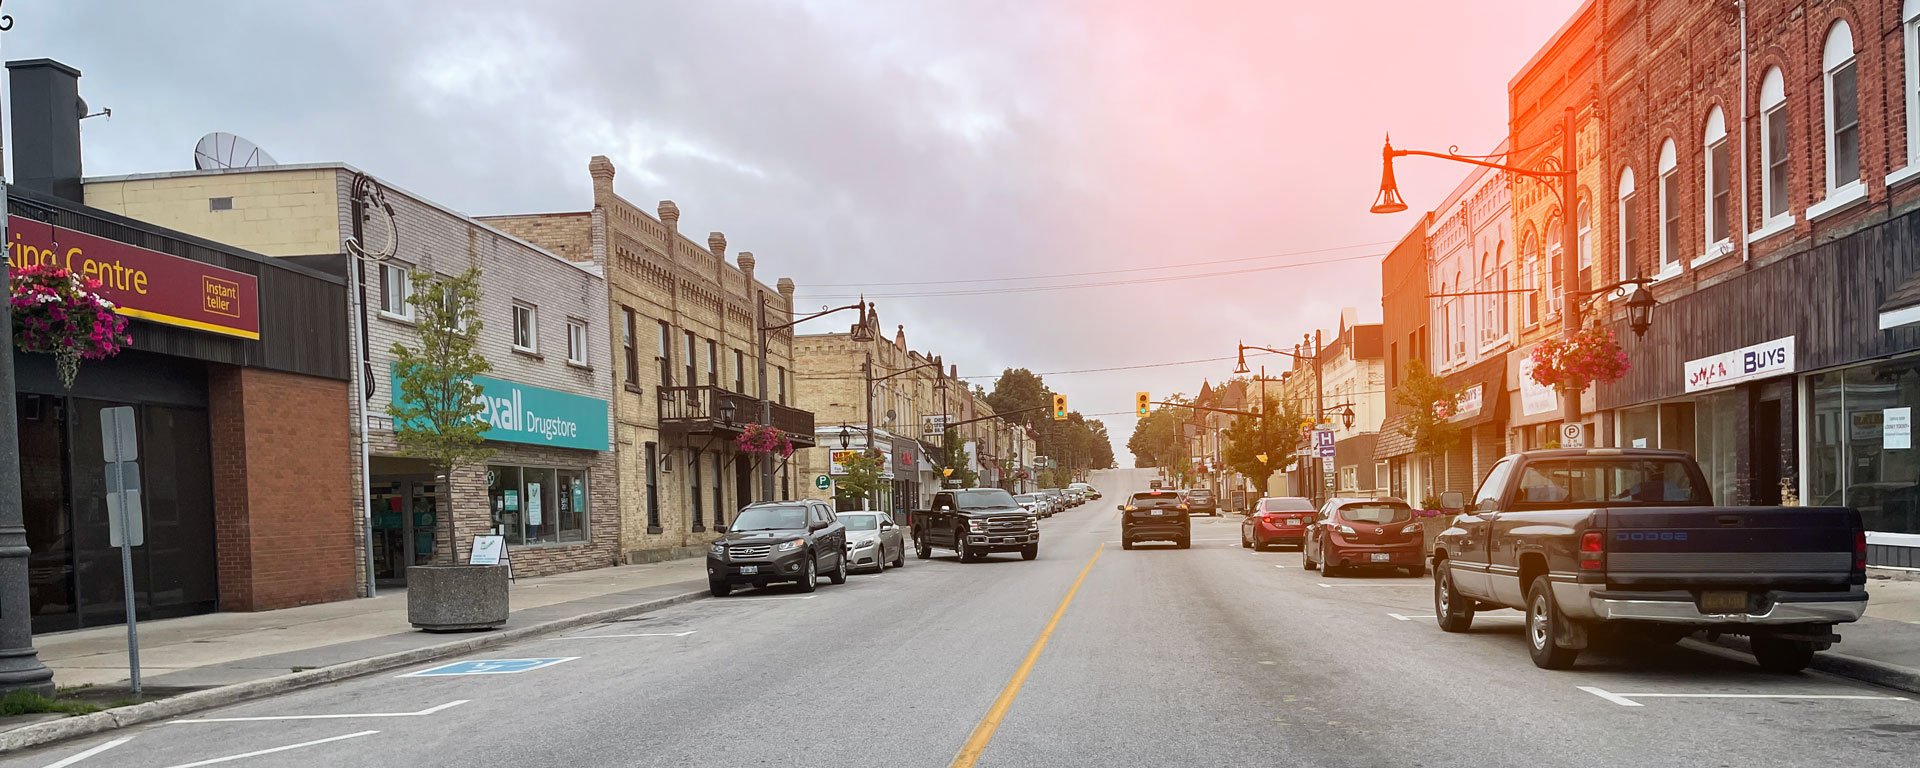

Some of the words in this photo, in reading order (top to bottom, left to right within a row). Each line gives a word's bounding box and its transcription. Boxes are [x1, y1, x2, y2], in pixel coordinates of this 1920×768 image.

[66, 248, 148, 295] Centre
[206, 280, 237, 299] Instant
[207, 298, 230, 311] teller
[1744, 347, 1785, 374] BUYS
[526, 411, 577, 440] Drugstore
[1569, 428, 1576, 436] P
[1321, 432, 1332, 445] H
[820, 476, 826, 484] P
[1616, 532, 1688, 541] DODGE
